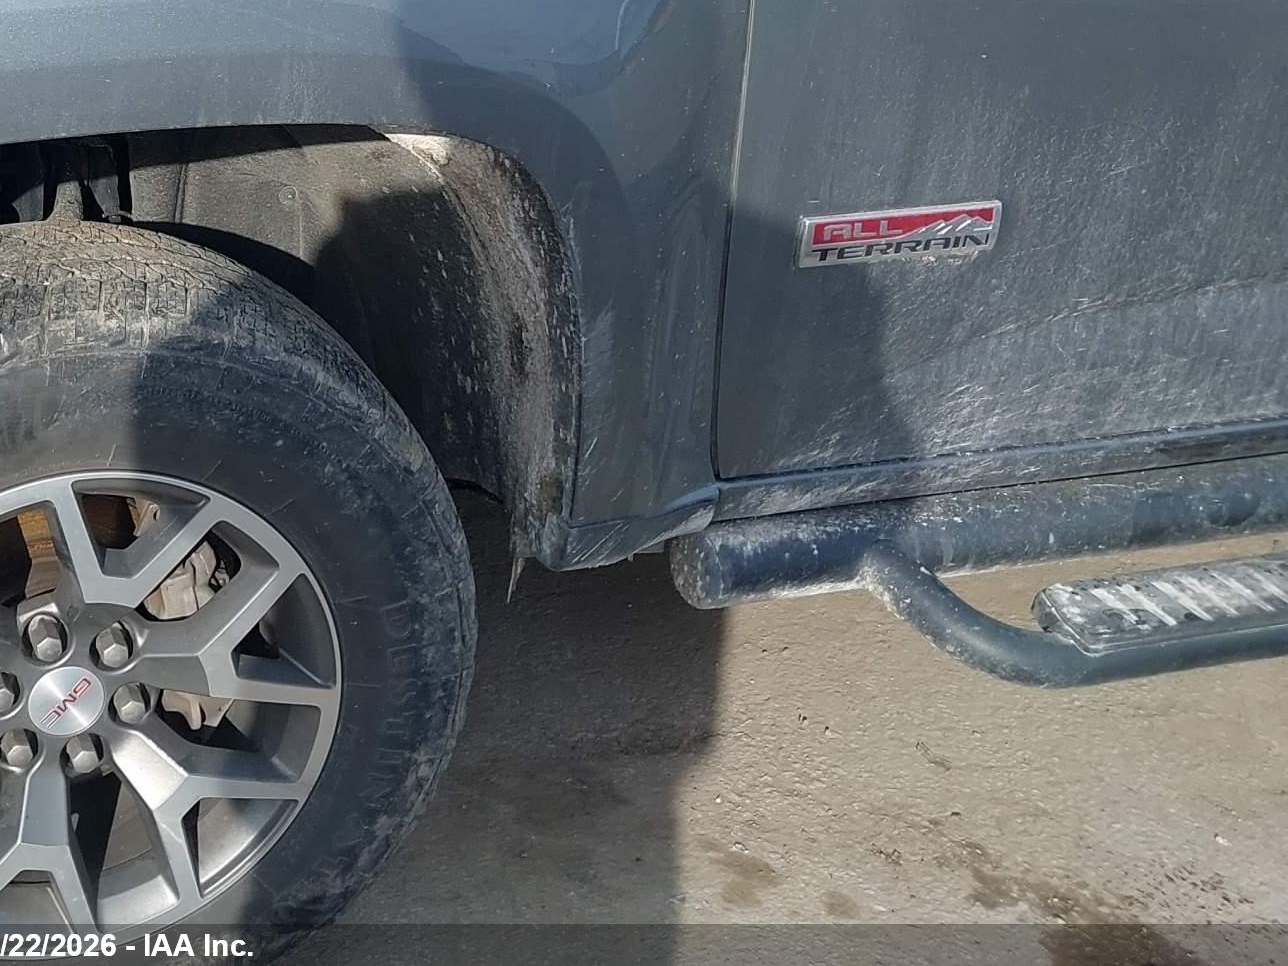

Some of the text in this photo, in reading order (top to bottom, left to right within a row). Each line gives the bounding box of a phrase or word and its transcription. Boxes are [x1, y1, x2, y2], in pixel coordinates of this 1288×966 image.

[823, 220, 903, 241] ALL
[811, 232, 990, 262] TERRAIN
[40, 677, 92, 729] GMC
